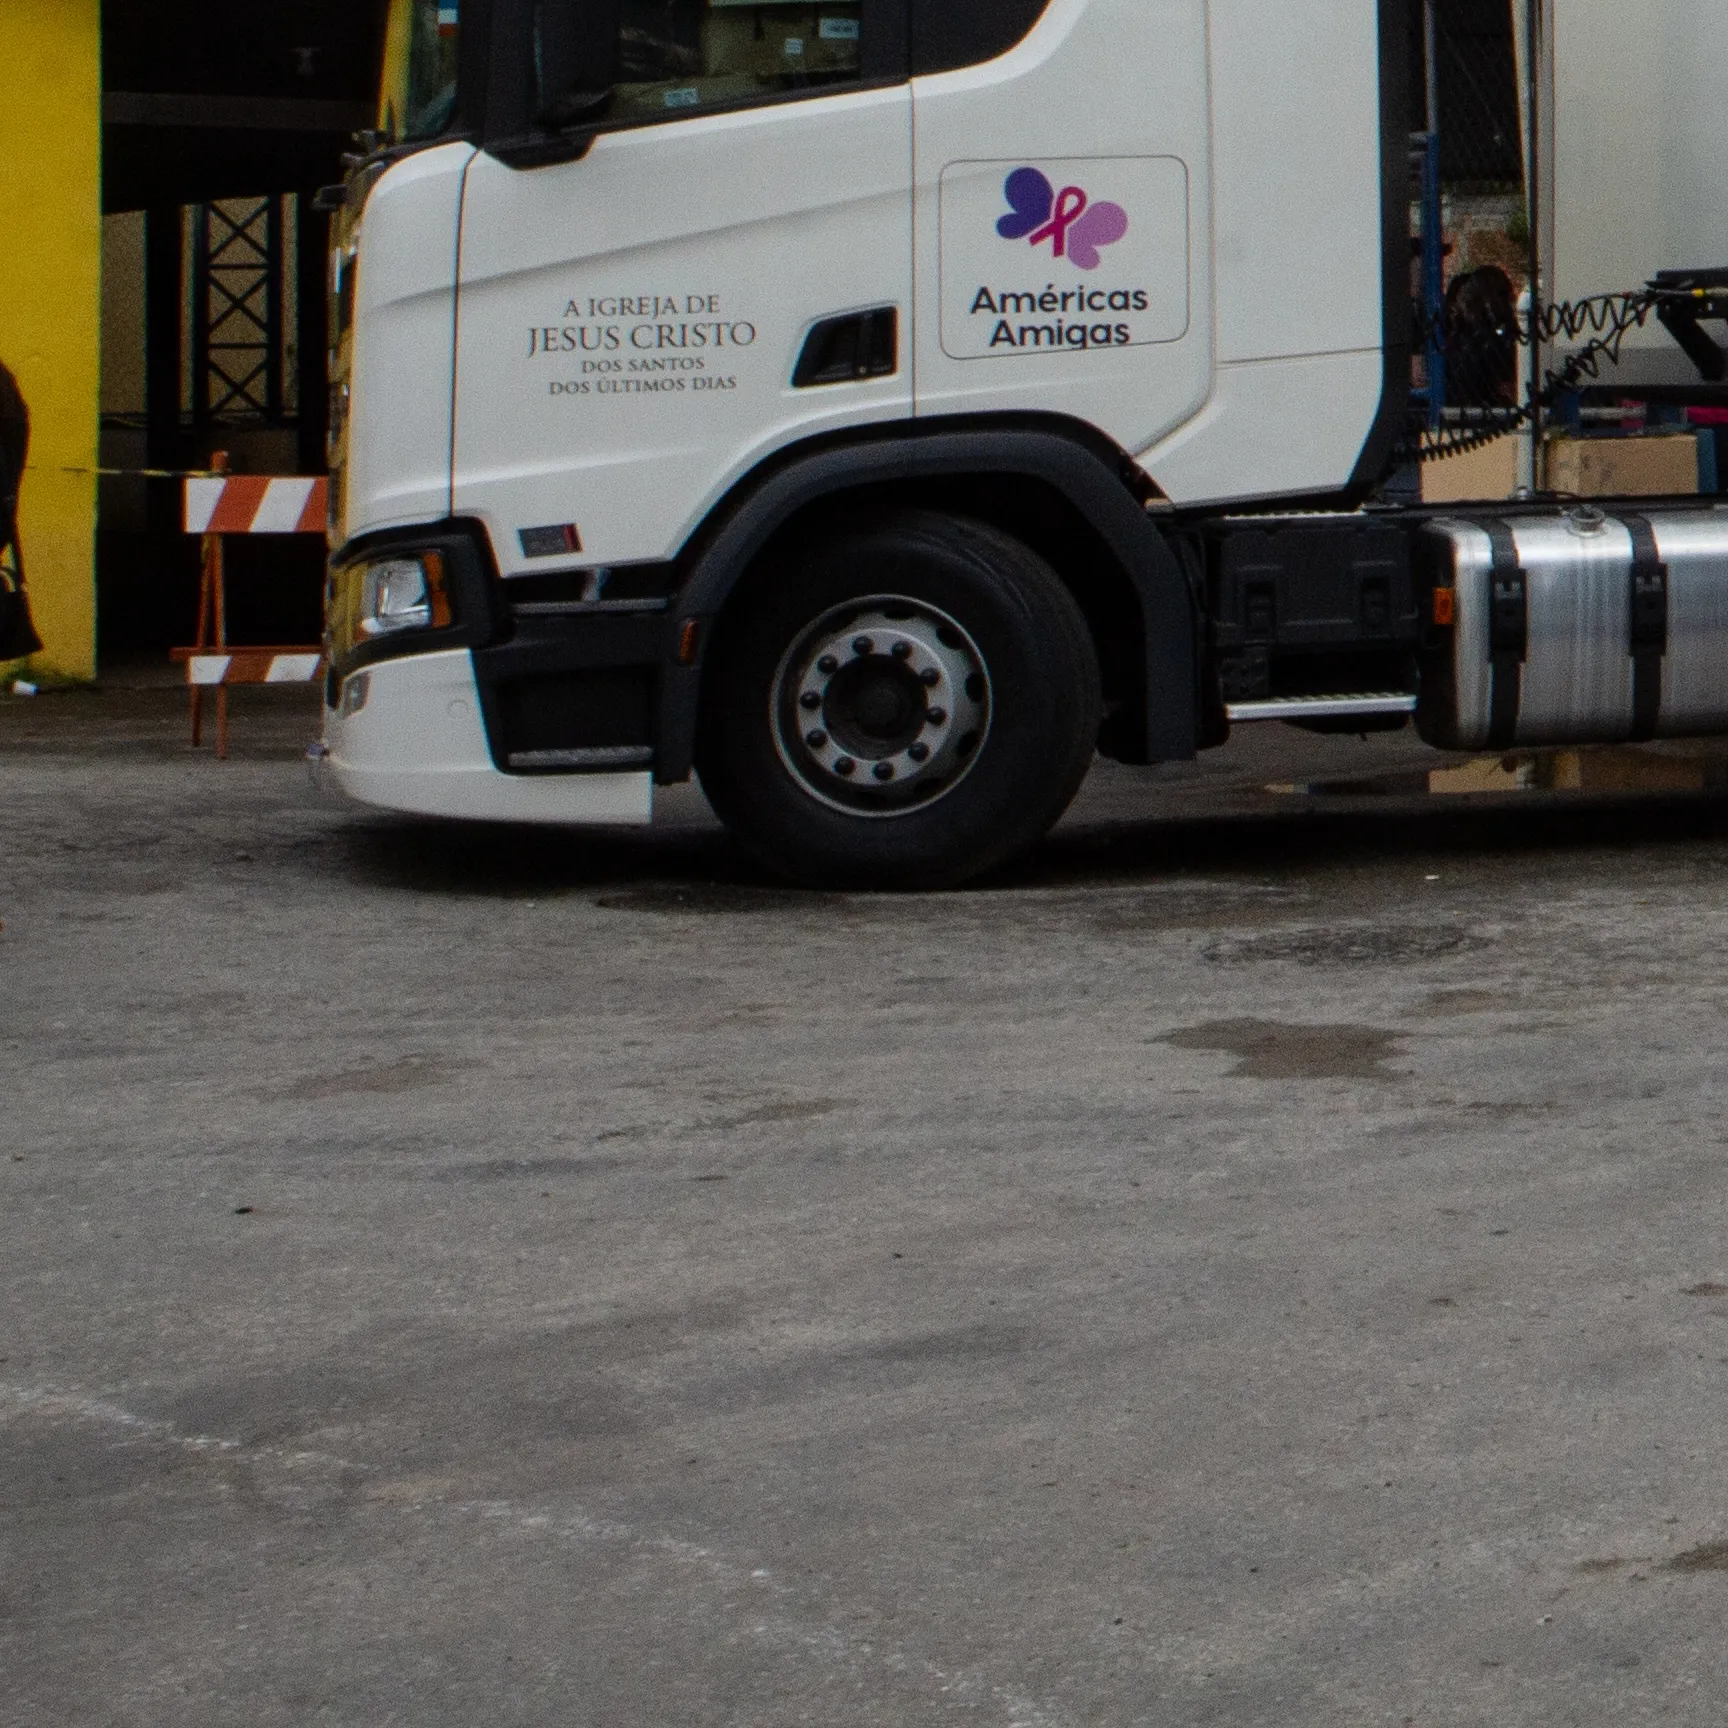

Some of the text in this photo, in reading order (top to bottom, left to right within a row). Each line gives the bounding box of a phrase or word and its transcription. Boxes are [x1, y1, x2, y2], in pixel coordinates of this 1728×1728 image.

[563, 295, 719, 319] A IGREJA DE
[970, 283, 1148, 315] Américas
[527, 322, 757, 357] JESUS CRISTO
[989, 319, 1130, 350] Amigas
[581, 356, 705, 373] DOS SANTOS
[549, 375, 737, 395] DOS ÚLTIMOS DIAS
